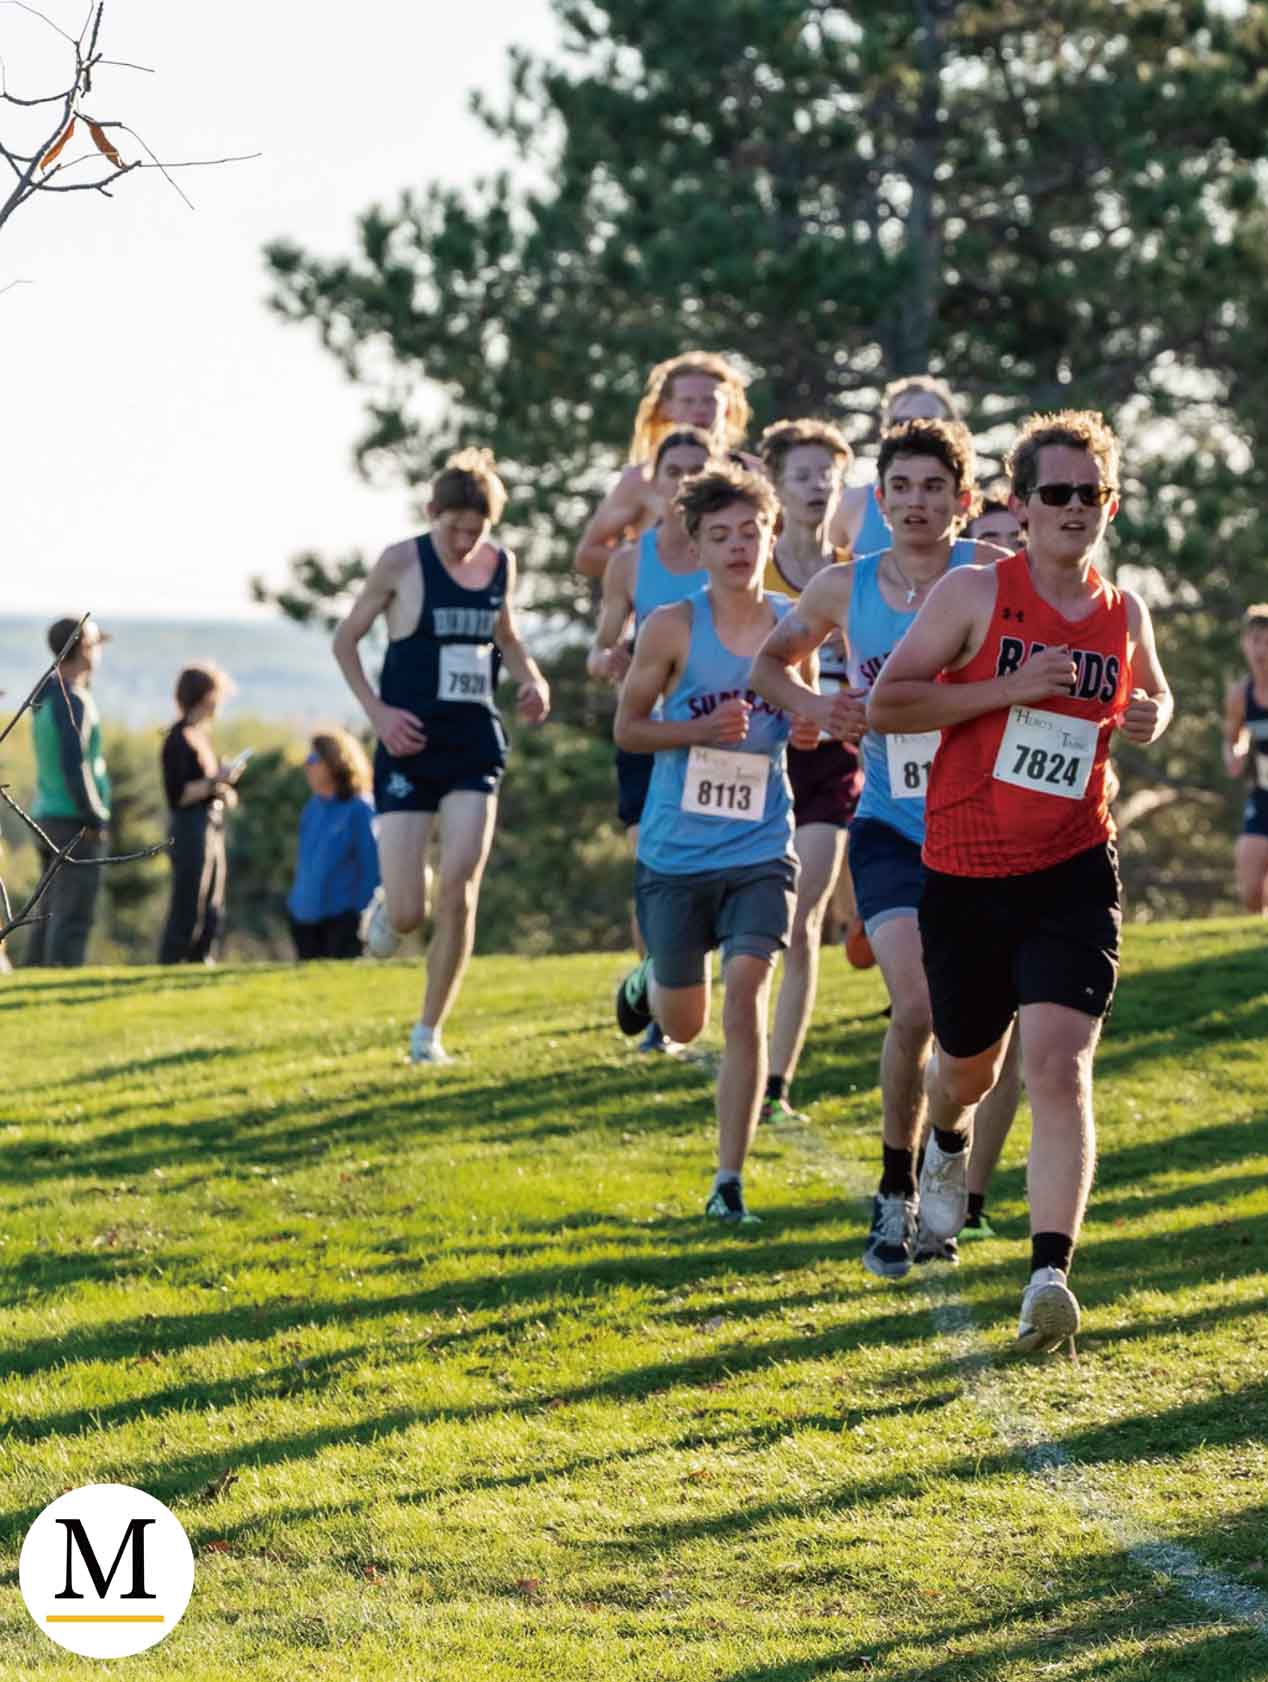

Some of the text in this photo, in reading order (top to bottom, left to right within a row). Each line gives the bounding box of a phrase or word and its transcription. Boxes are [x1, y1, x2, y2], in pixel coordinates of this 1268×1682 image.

[995, 635, 1121, 704] RIDS
[1012, 743, 1081, 787] 7824
[697, 779, 752, 811] 8113
